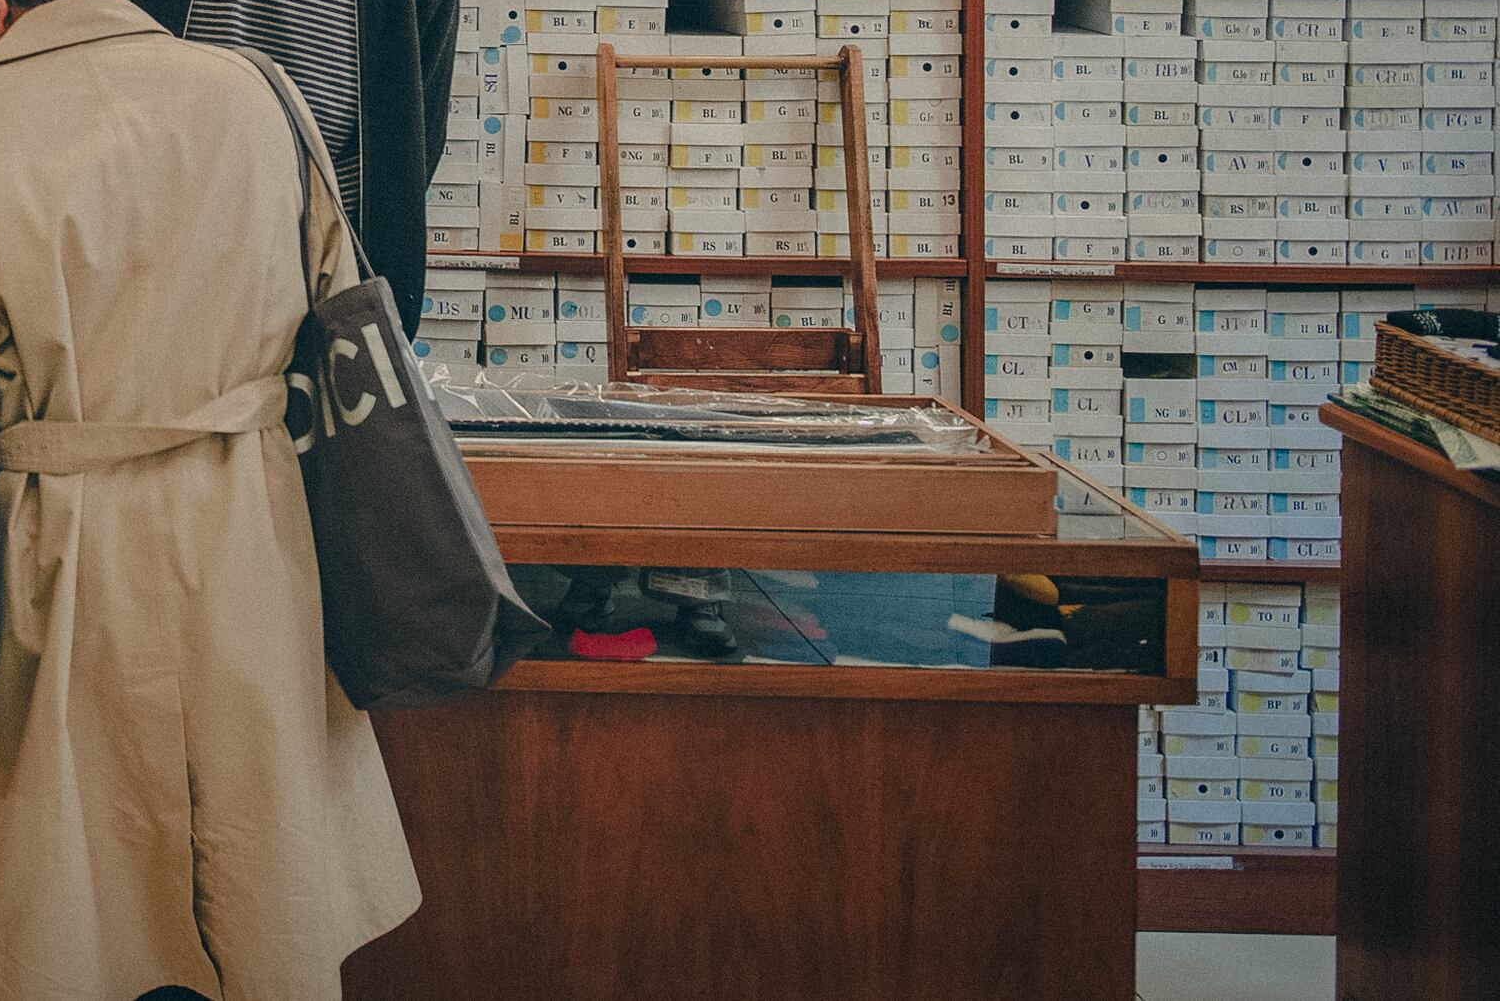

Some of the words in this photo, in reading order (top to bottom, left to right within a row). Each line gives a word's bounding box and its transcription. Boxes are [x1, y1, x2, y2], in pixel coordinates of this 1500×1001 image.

[918, 19, 933, 29] BL
[1076, 65, 1092, 75] BL
[1451, 69, 1466, 79] BL
[557, 106, 573, 116] NG
[702, 108, 717, 118] BL
[1008, 154, 1024, 165] BL
[439, 190, 453, 201] NG
[919, 197, 934, 208] BL
[1304, 202, 1320, 212] BL
[1230, 204, 1244, 214] RS
[552, 236, 568, 247] BL
[702, 241, 716, 251] RS
[917, 243, 932, 253] BL
[1012, 244, 1027, 255] BL
[1158, 246, 1173, 256] BL
[510, 305, 535, 320] MU
[727, 303, 742, 314] LV
[800, 316, 817, 327] BL
[1317, 324, 1333, 334] BL
[1222, 361, 1238, 372] CM
[1155, 408, 1170, 418] NG
[1226, 454, 1241, 464] NG
[1293, 500, 1306, 511] BL
[1227, 543, 1241, 553] LV
